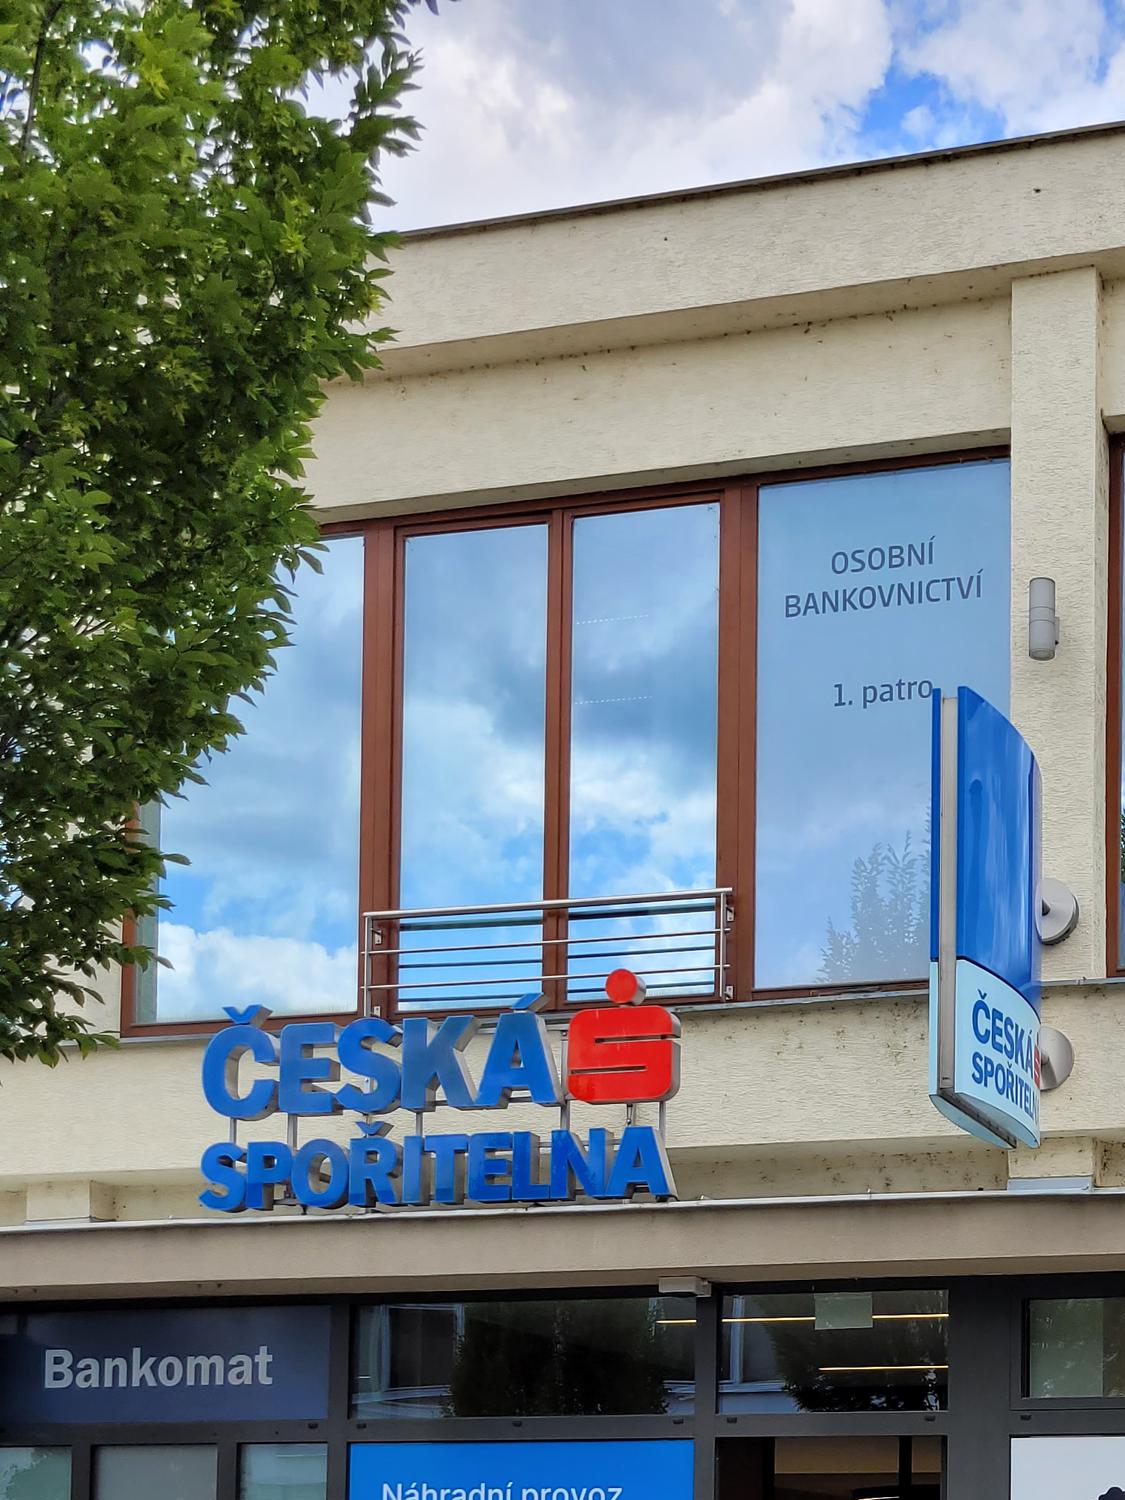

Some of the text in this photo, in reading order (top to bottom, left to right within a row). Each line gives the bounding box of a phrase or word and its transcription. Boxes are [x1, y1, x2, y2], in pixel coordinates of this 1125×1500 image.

[831, 535, 935, 574] OSOBNÍ
[785, 568, 984, 618] BANKOVNICTVÍ
[833, 679, 934, 708] 1. patro
[202, 992, 564, 1120] ČESKÁ
[972, 988, 1034, 1080] ČESKÁ
[972, 1051, 1039, 1125] SPOŘITEL
[200, 1121, 678, 1212] SPOŘITELNA
[44, 1345, 274, 1389] Bankomat
